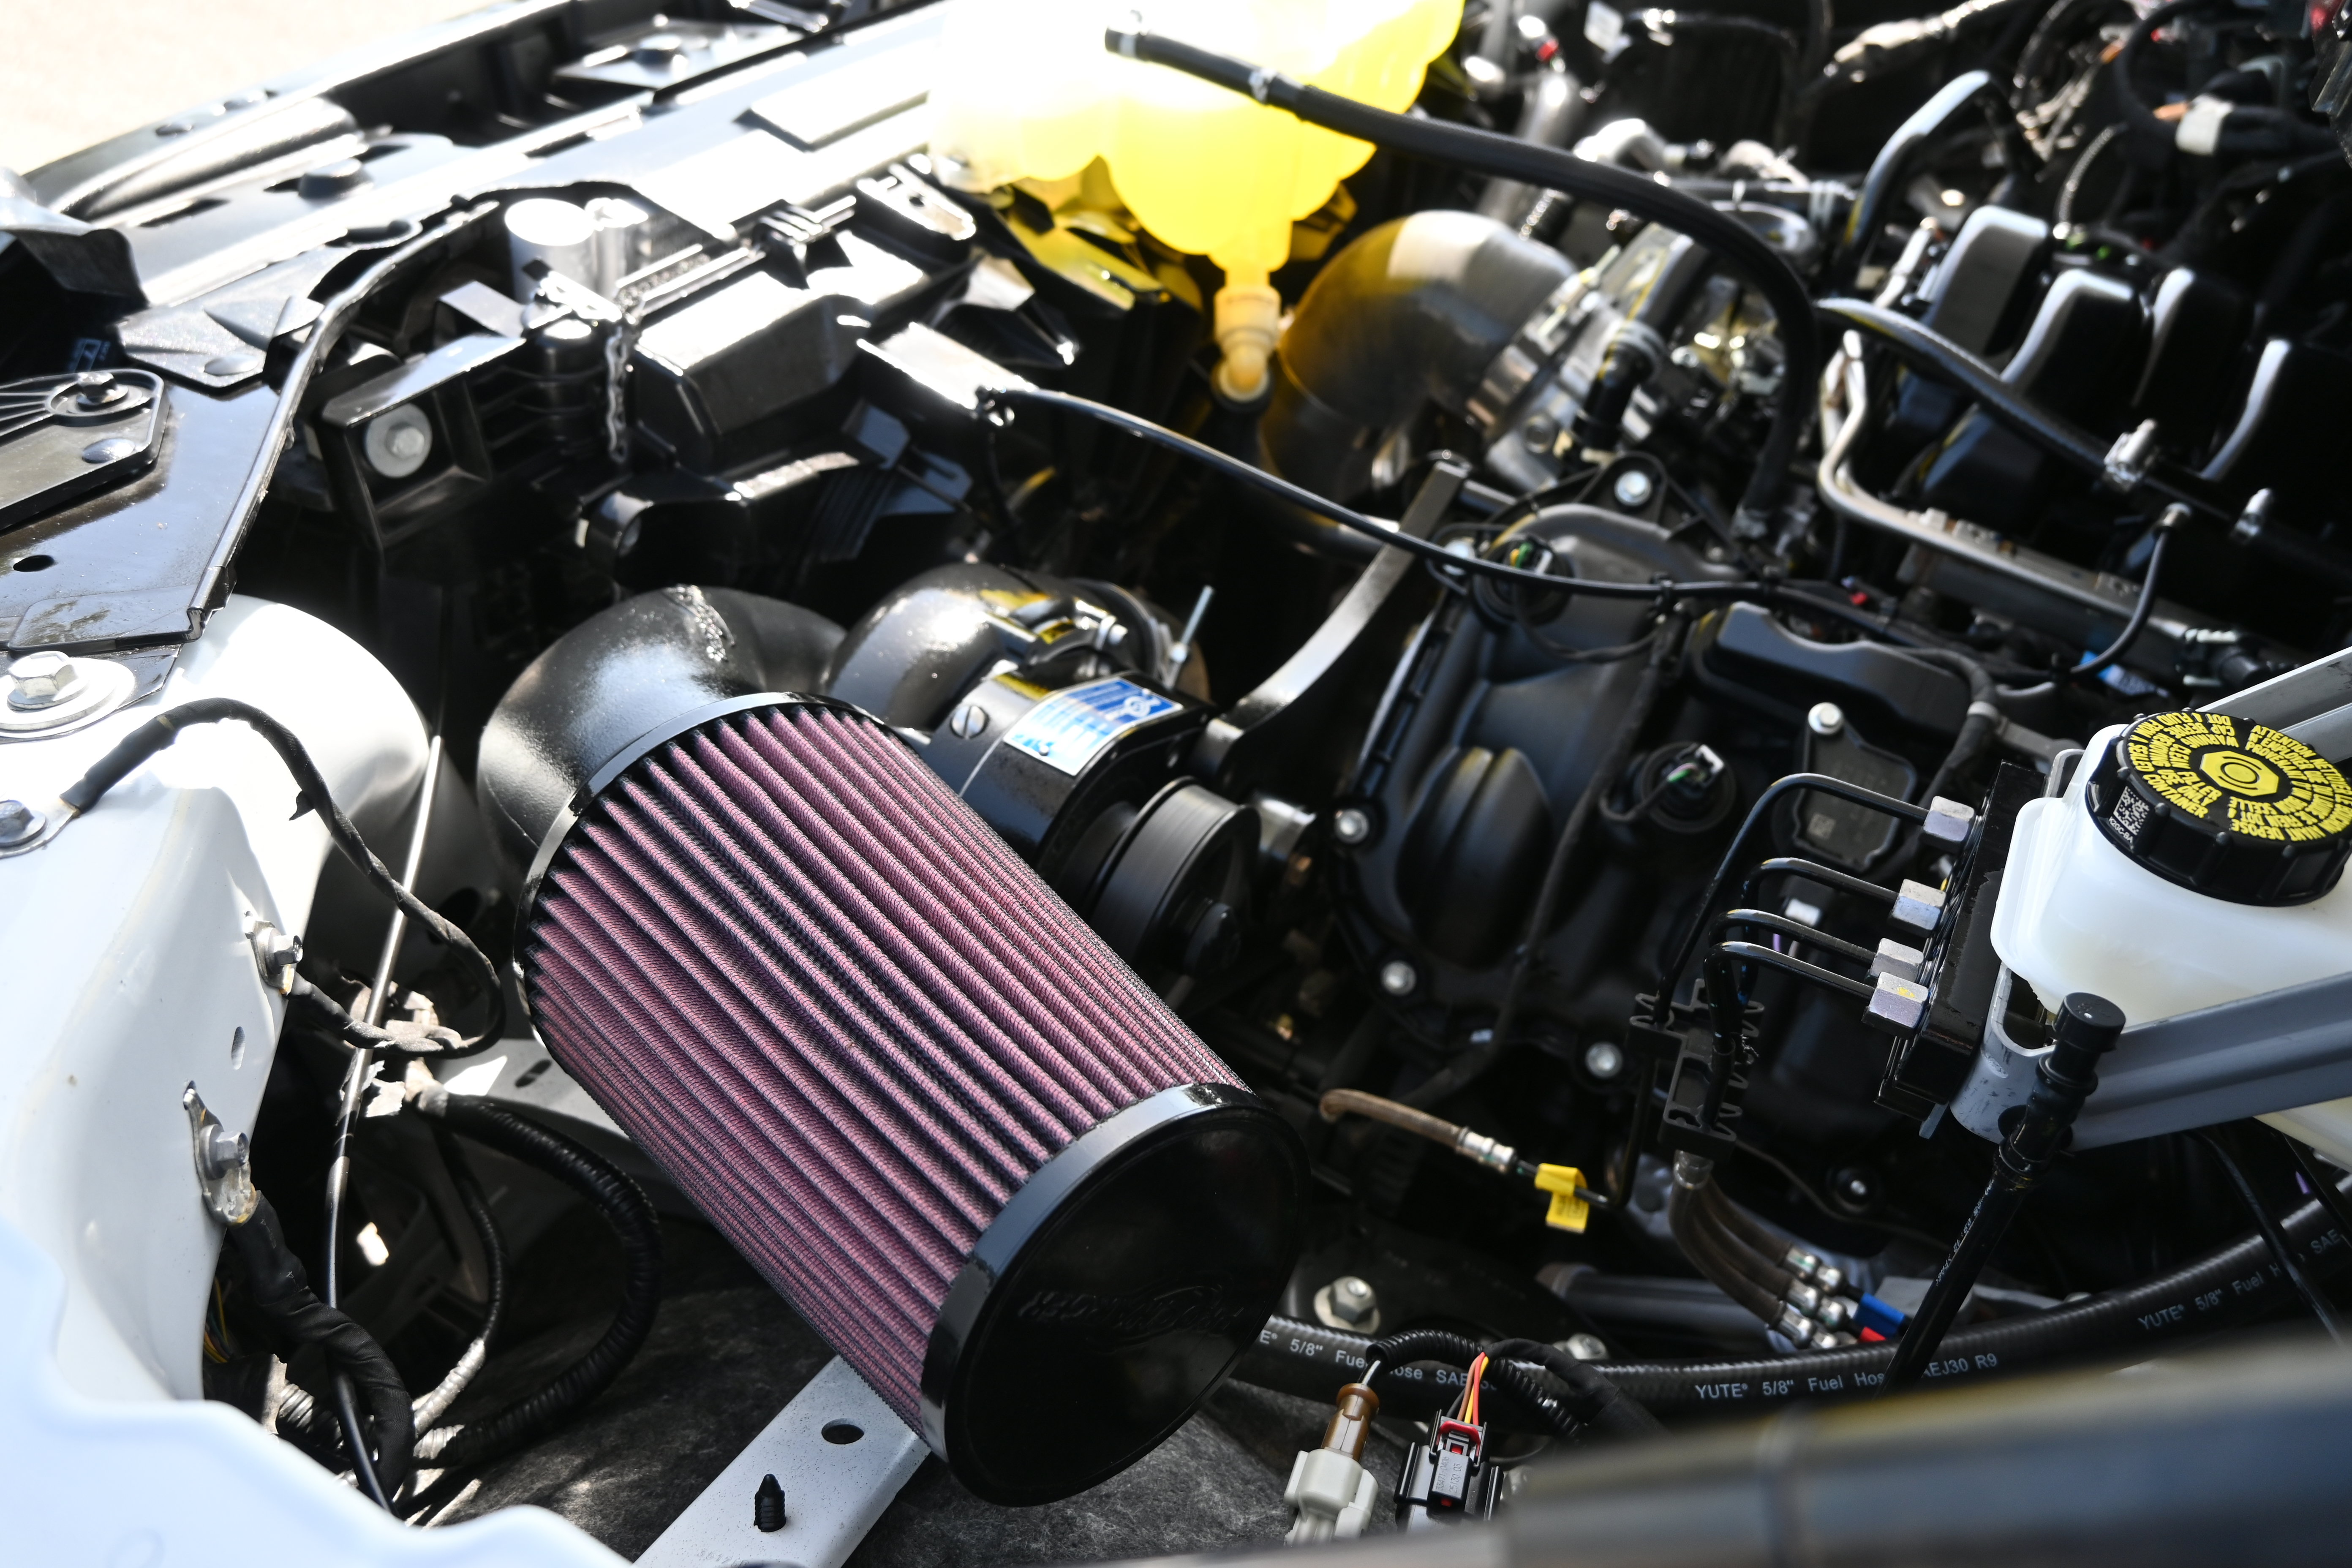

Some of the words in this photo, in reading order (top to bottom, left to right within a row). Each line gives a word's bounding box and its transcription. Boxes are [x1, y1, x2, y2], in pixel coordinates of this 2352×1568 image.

[2134, 719, 2164, 738] FROM
[2156, 713, 2193, 725] FLUID
[2205, 713, 2231, 726] DOT
[2129, 735, 2149, 743] A
[2163, 722, 2209, 739] BEFORE
[2211, 724, 2235, 736] CAP
[2149, 733, 2175, 767] REMOVING
[2180, 734, 2239, 748] WARNING
[2251, 725, 2316, 757] ATTENTION
[2128, 743, 2154, 772] SEALED
[2169, 744, 2191, 769] CLEAN
[2245, 741, 2308, 780] PROVENANT
[2157, 770, 2185, 785] USE
[2177, 772, 2222, 800] FILLER
[2303, 770, 2329, 784] QUE
[2143, 774, 2208, 818] CONTAINER
[2177, 786, 2213, 806] ONLY
[2228, 796, 2278, 814] SCELLE
[2240, 811, 2265, 825] DOT
[2230, 819, 2285, 841] DEPOSE
[2231, 1271, 2265, 1296] Fuel
[1335, 1350, 1367, 1368] Fue
[1390, 1367, 1423, 1380] ose
[1763, 1379, 1794, 1395] 5/8"
[1808, 1375, 1843, 1392] Fuel
[1854, 1372, 1885, 1386] Hos
[1974, 1353, 1998, 1369] R9
